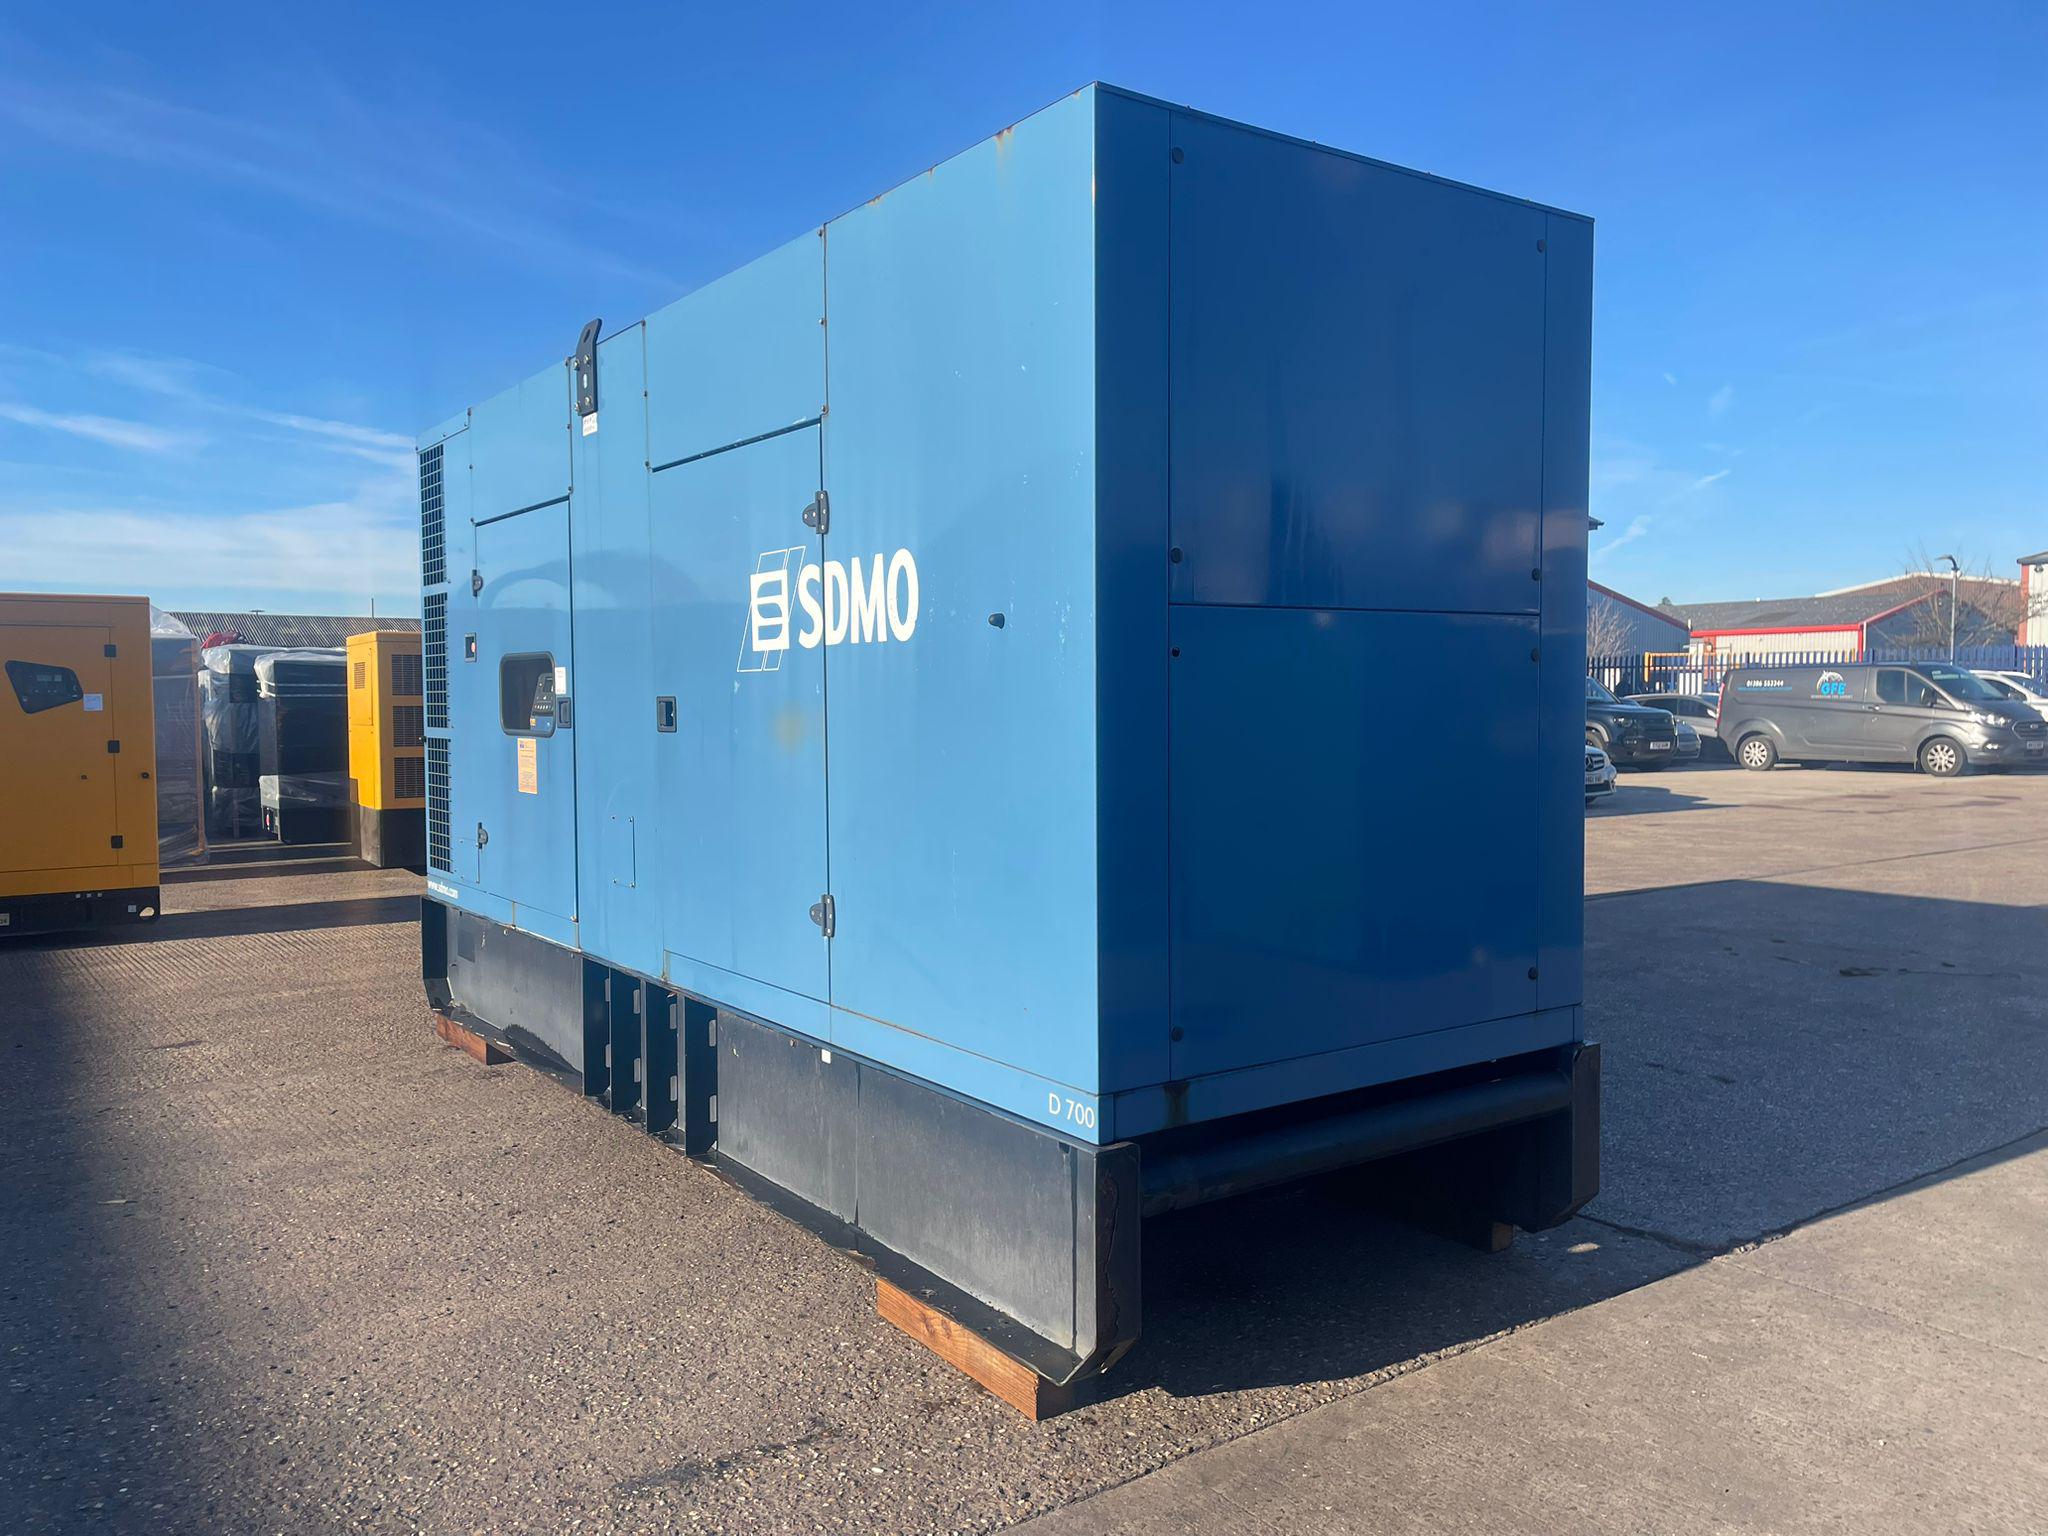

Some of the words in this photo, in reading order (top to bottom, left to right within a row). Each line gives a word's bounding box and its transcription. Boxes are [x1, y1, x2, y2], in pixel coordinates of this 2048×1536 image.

[798, 548, 919, 648] SDMO
[1820, 682, 1846, 695] GFE
[1049, 1093, 1061, 1115] D
[1065, 1099, 1095, 1128] 700
